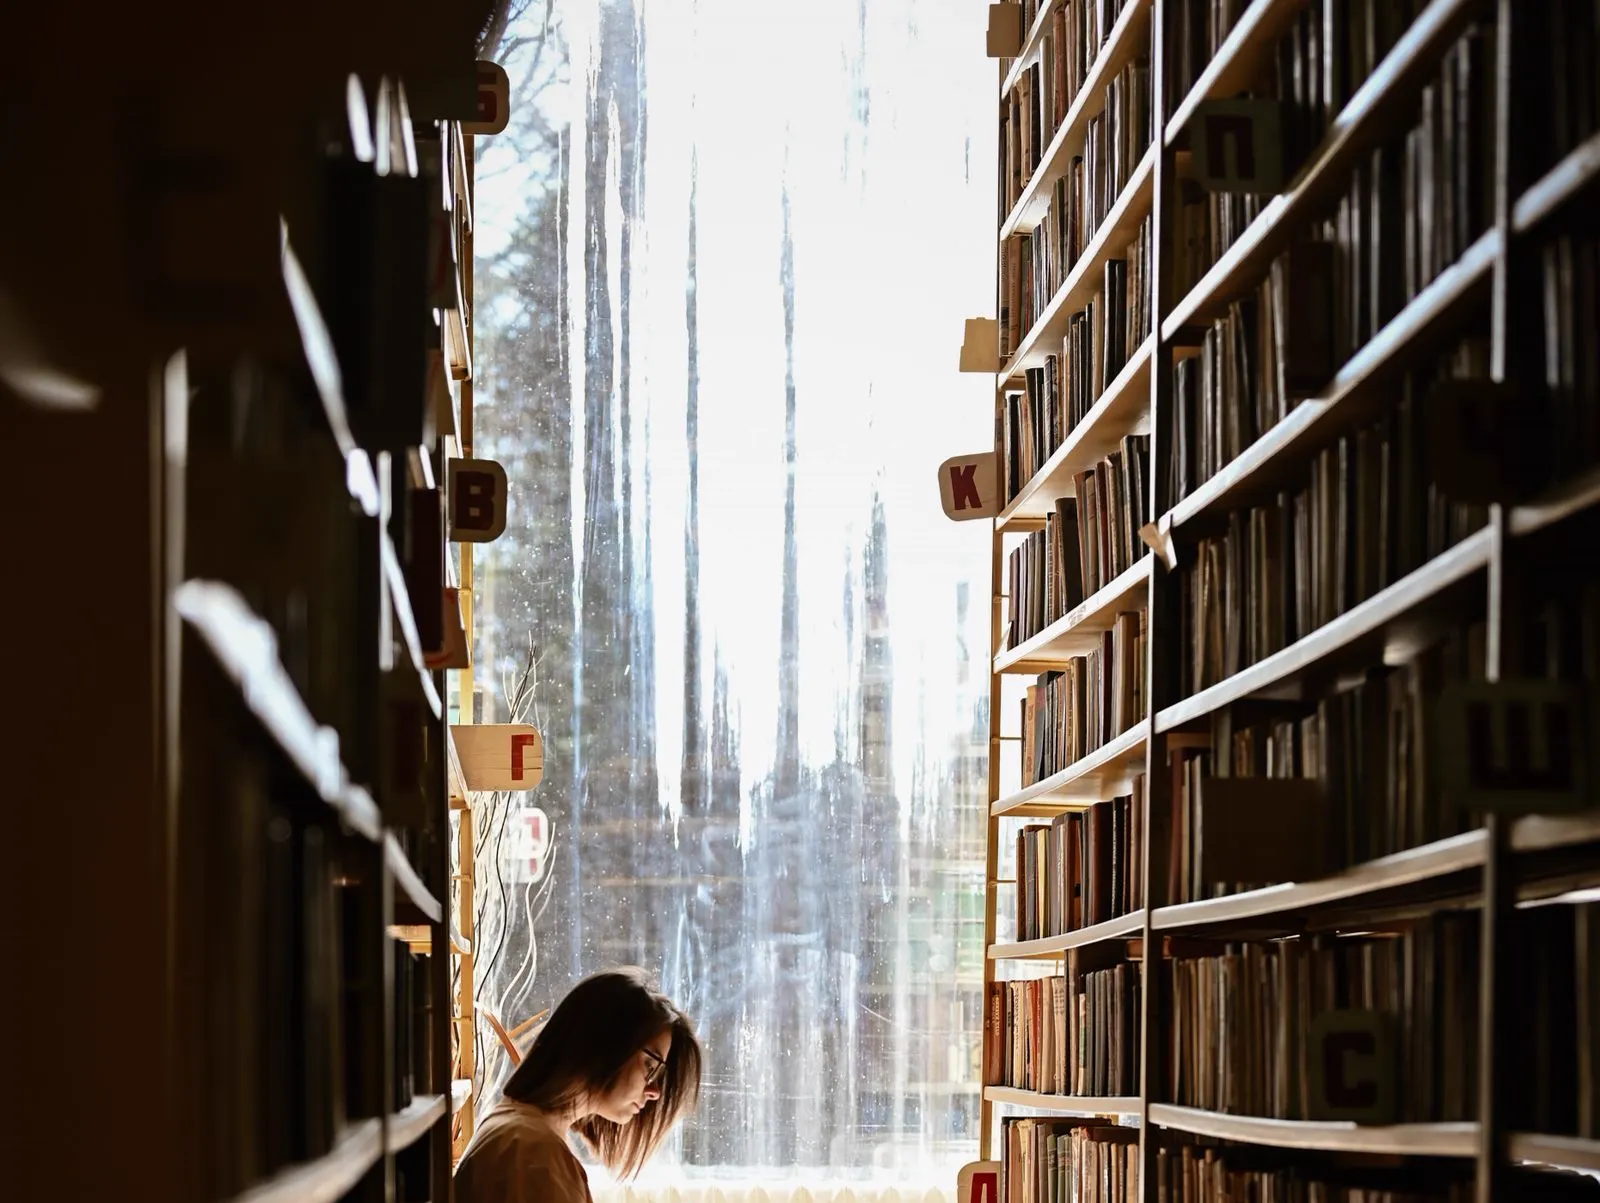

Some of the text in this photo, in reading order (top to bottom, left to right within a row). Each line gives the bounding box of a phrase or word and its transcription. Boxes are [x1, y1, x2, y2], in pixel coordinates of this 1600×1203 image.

[1206, 115, 1254, 178] П
[455, 471, 494, 530] В
[950, 465, 982, 510] К
[511, 734, 534, 780] Г
[1469, 702, 1571, 790] Ш
[1322, 1032, 1376, 1107] С
